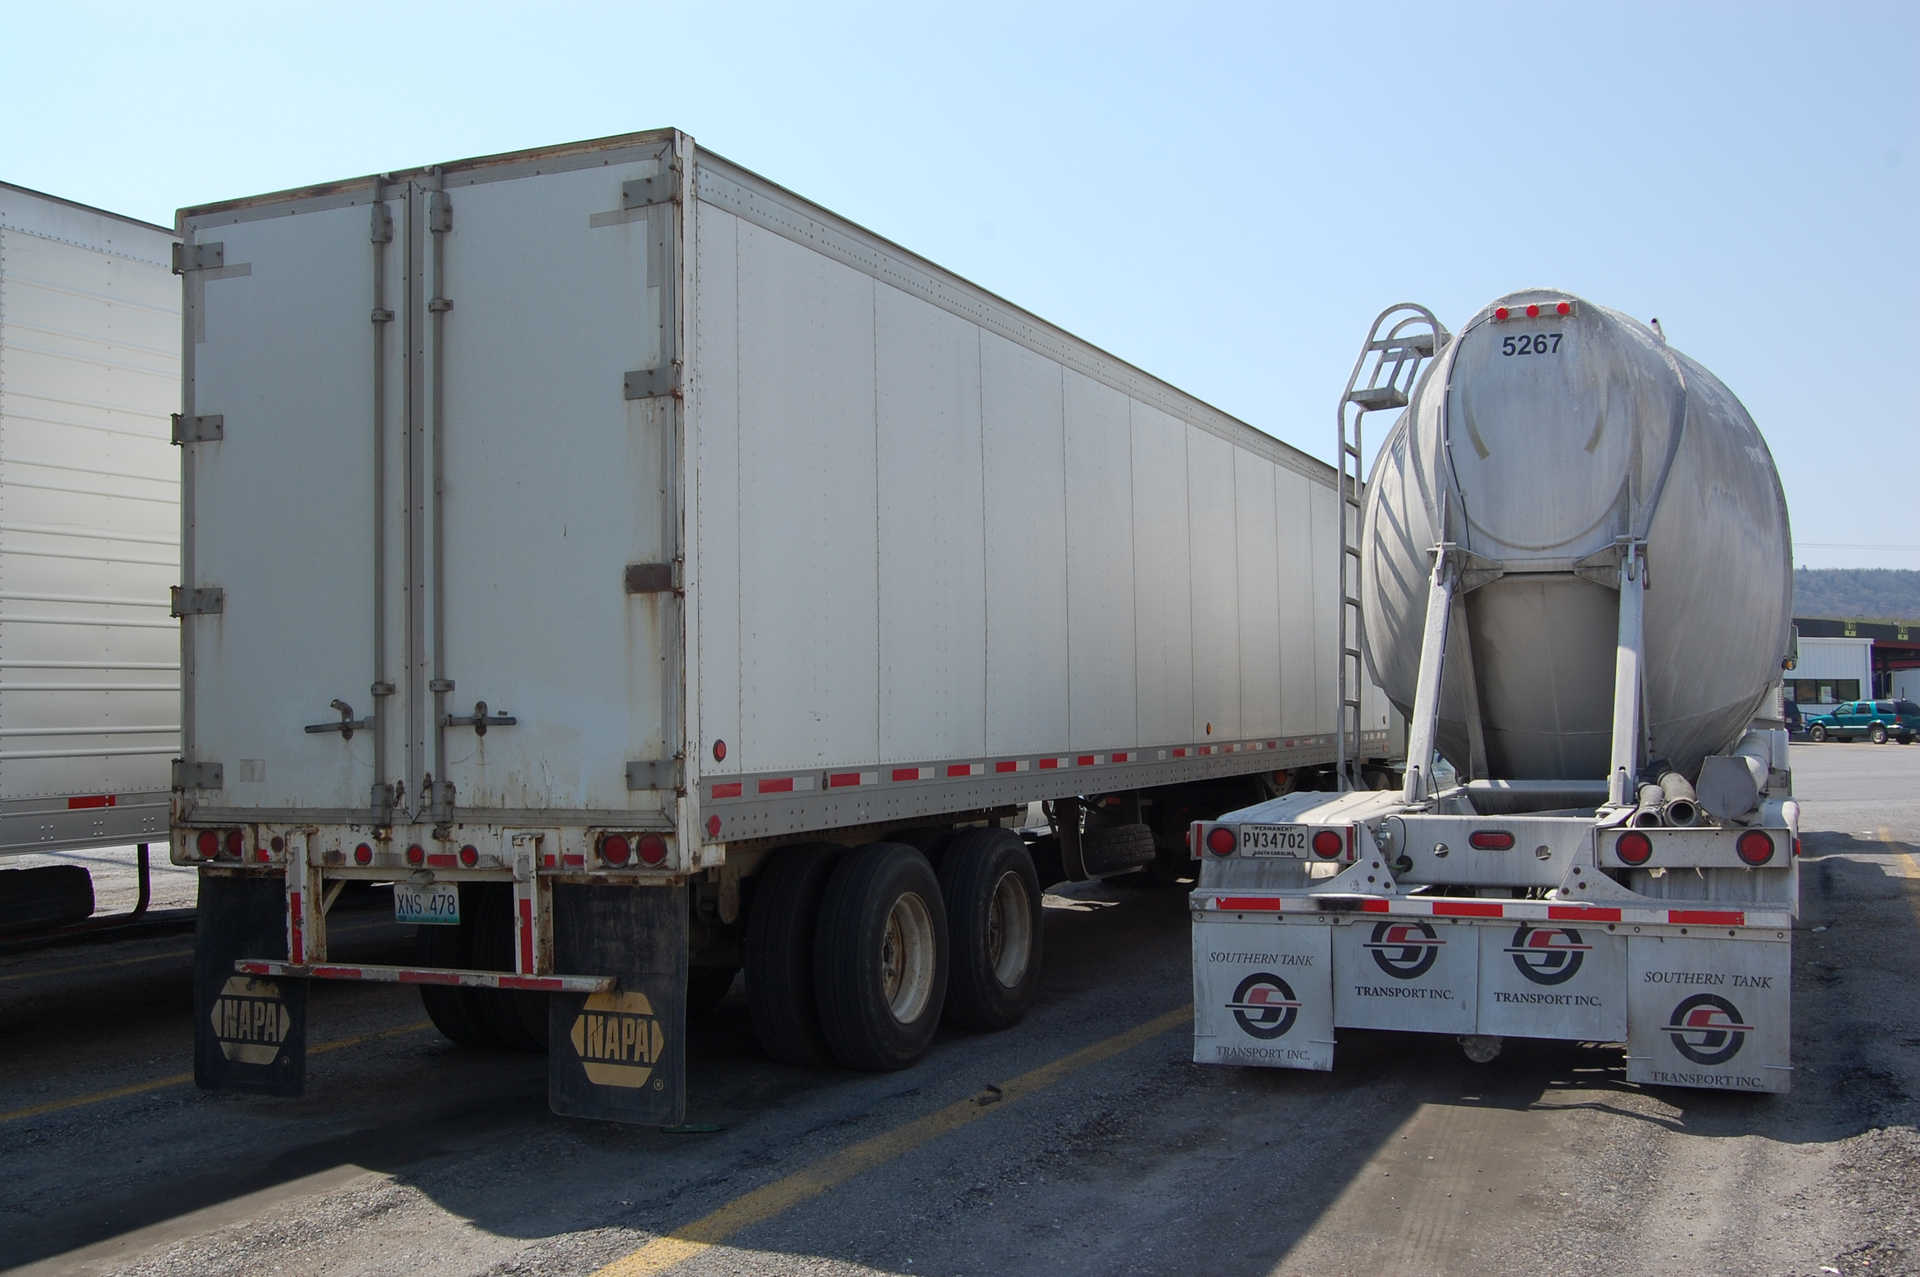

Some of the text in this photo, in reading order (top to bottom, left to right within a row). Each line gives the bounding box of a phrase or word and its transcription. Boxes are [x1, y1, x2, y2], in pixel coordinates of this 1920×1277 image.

[1502, 333, 1563, 356] 5267
[1243, 832, 1305, 849] PV34702
[397, 893, 456, 916] XNS 478
[1209, 951, 1315, 967] SOUTHERN TANK
[1644, 971, 1773, 989] SOUTHERN TANK
[1355, 986, 1455, 1000] TRANSPORT INC.
[1493, 991, 1602, 1007] TRANSPORT INC.
[223, 999, 278, 1042] NAPA
[587, 1014, 650, 1063] NAPA
[1215, 1045, 1311, 1061] TRANSPORT INC.
[1651, 1071, 1764, 1089] TRANSPORT INC.
